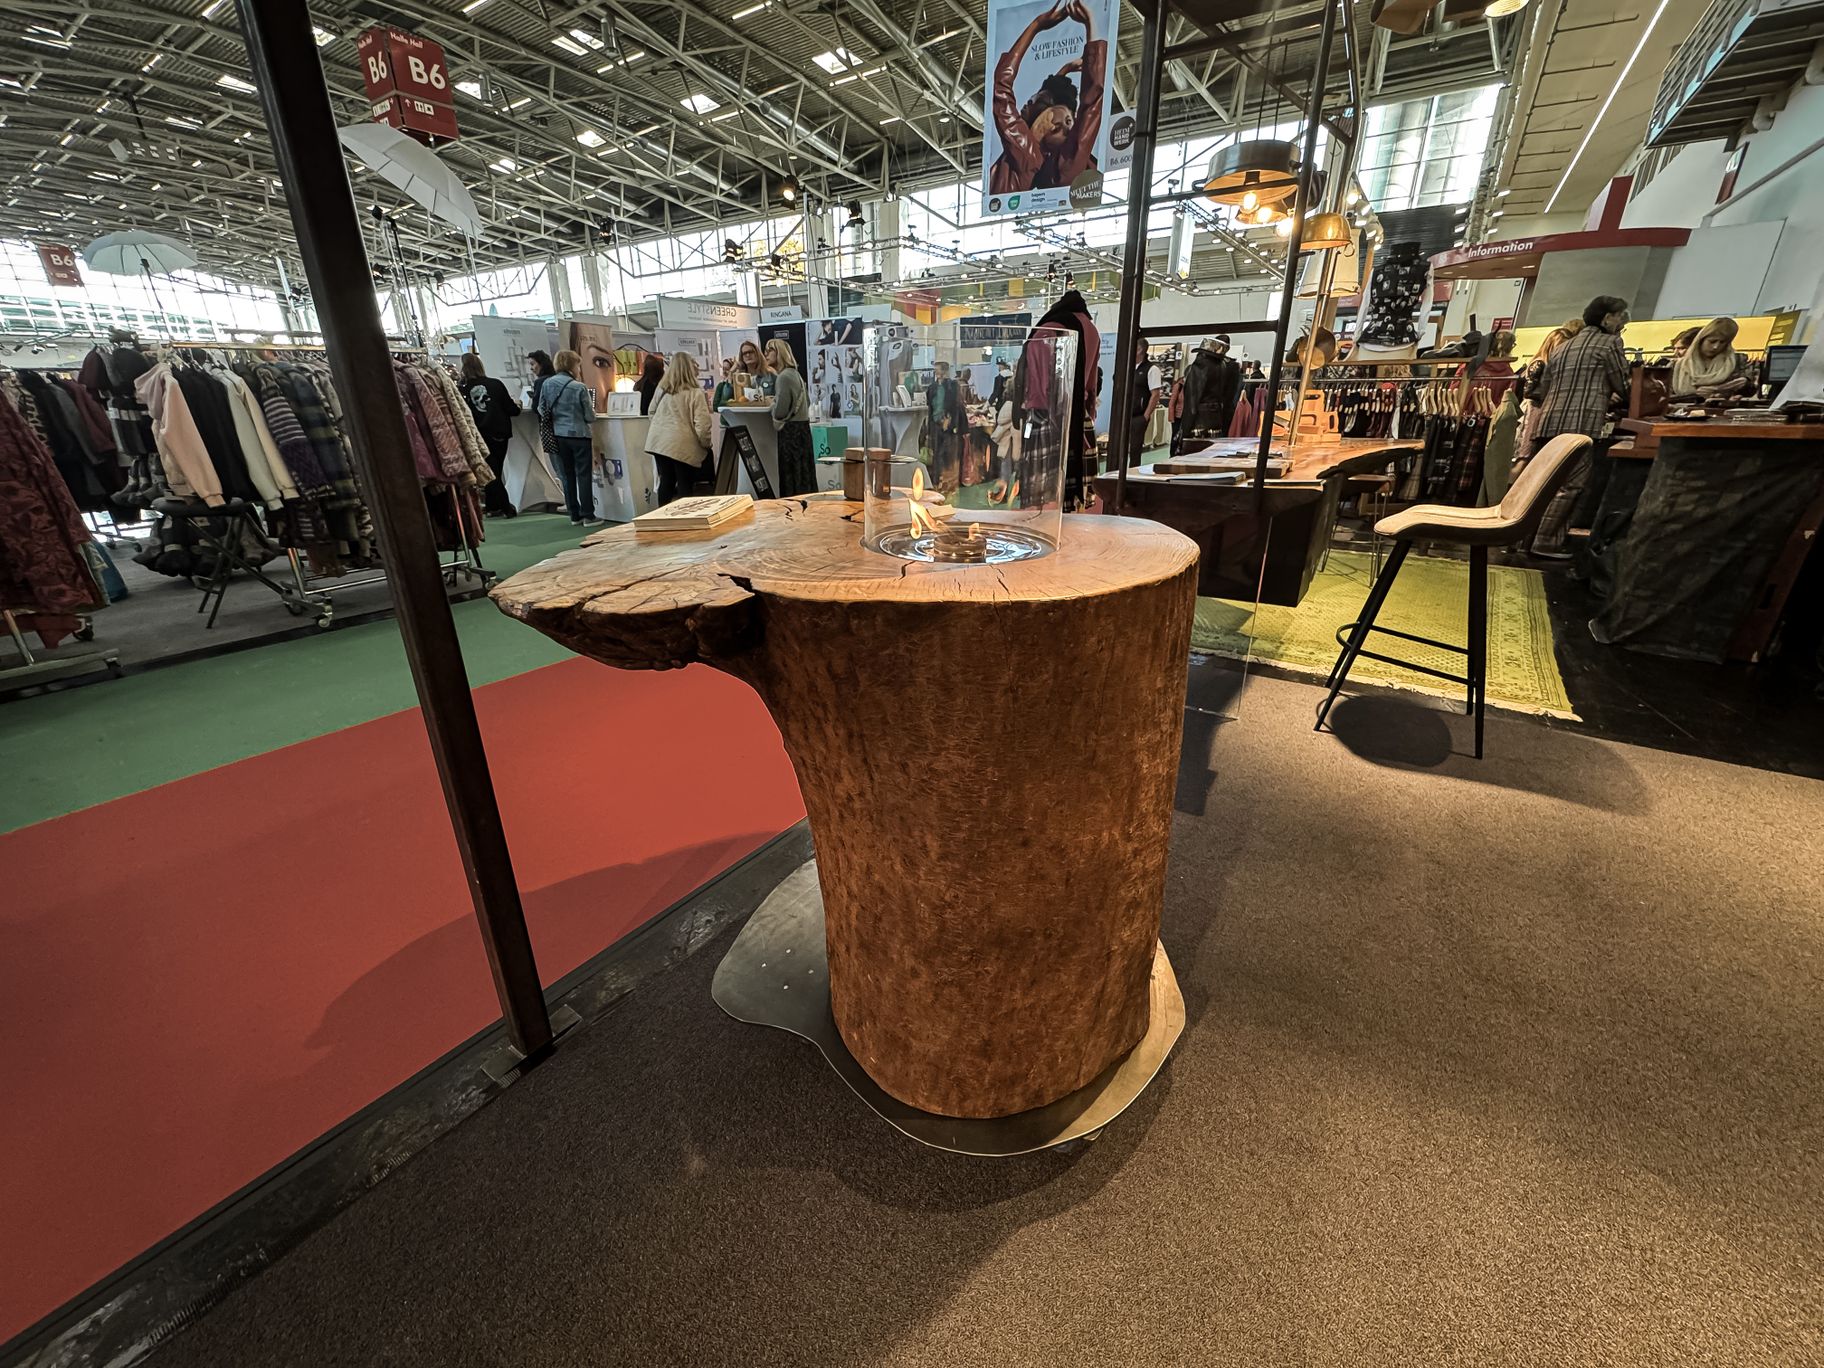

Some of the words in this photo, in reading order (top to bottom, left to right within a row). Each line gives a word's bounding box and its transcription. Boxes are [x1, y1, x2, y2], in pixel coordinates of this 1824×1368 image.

[1052, 35, 1084, 49] FASHION
[1034, 53, 1040, 61] &
[1041, 45, 1079, 60] LIFESTYLE
[368, 51, 387, 84] B6
[408, 55, 446, 90] B6
[1076, 190, 1101, 200] MAKERS
[1468, 241, 1533, 258] Information
[50, 253, 74, 267] B6
[770, 310, 792, 318] RINGANA
